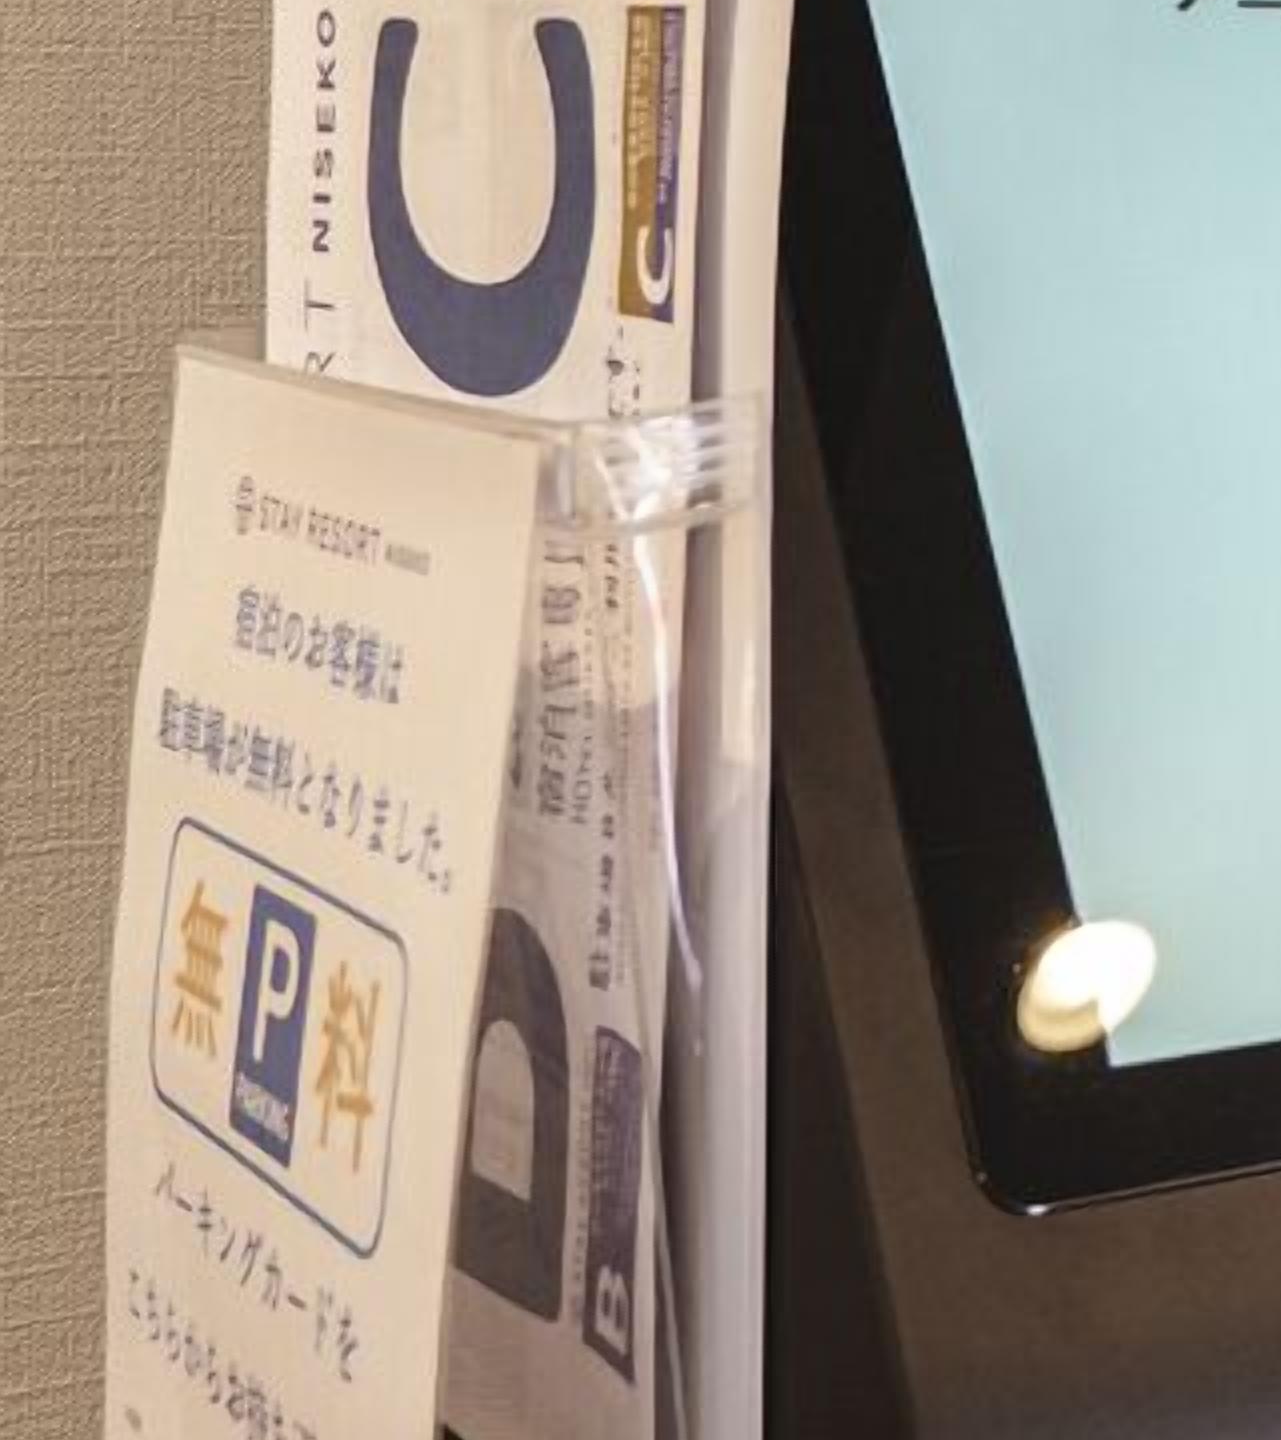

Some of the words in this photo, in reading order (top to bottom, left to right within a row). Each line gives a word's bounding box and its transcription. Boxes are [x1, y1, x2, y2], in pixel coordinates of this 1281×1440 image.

[309, 7, 337, 254] NISEKO
[367, 17, 596, 397] C
[234, 584, 405, 704] 宿泊のお客様は
[158, 684, 453, 895] 駐車場が無料となりました。
[253, 919, 300, 1062] P
[153, 1161, 360, 1384] パーキングカードを
